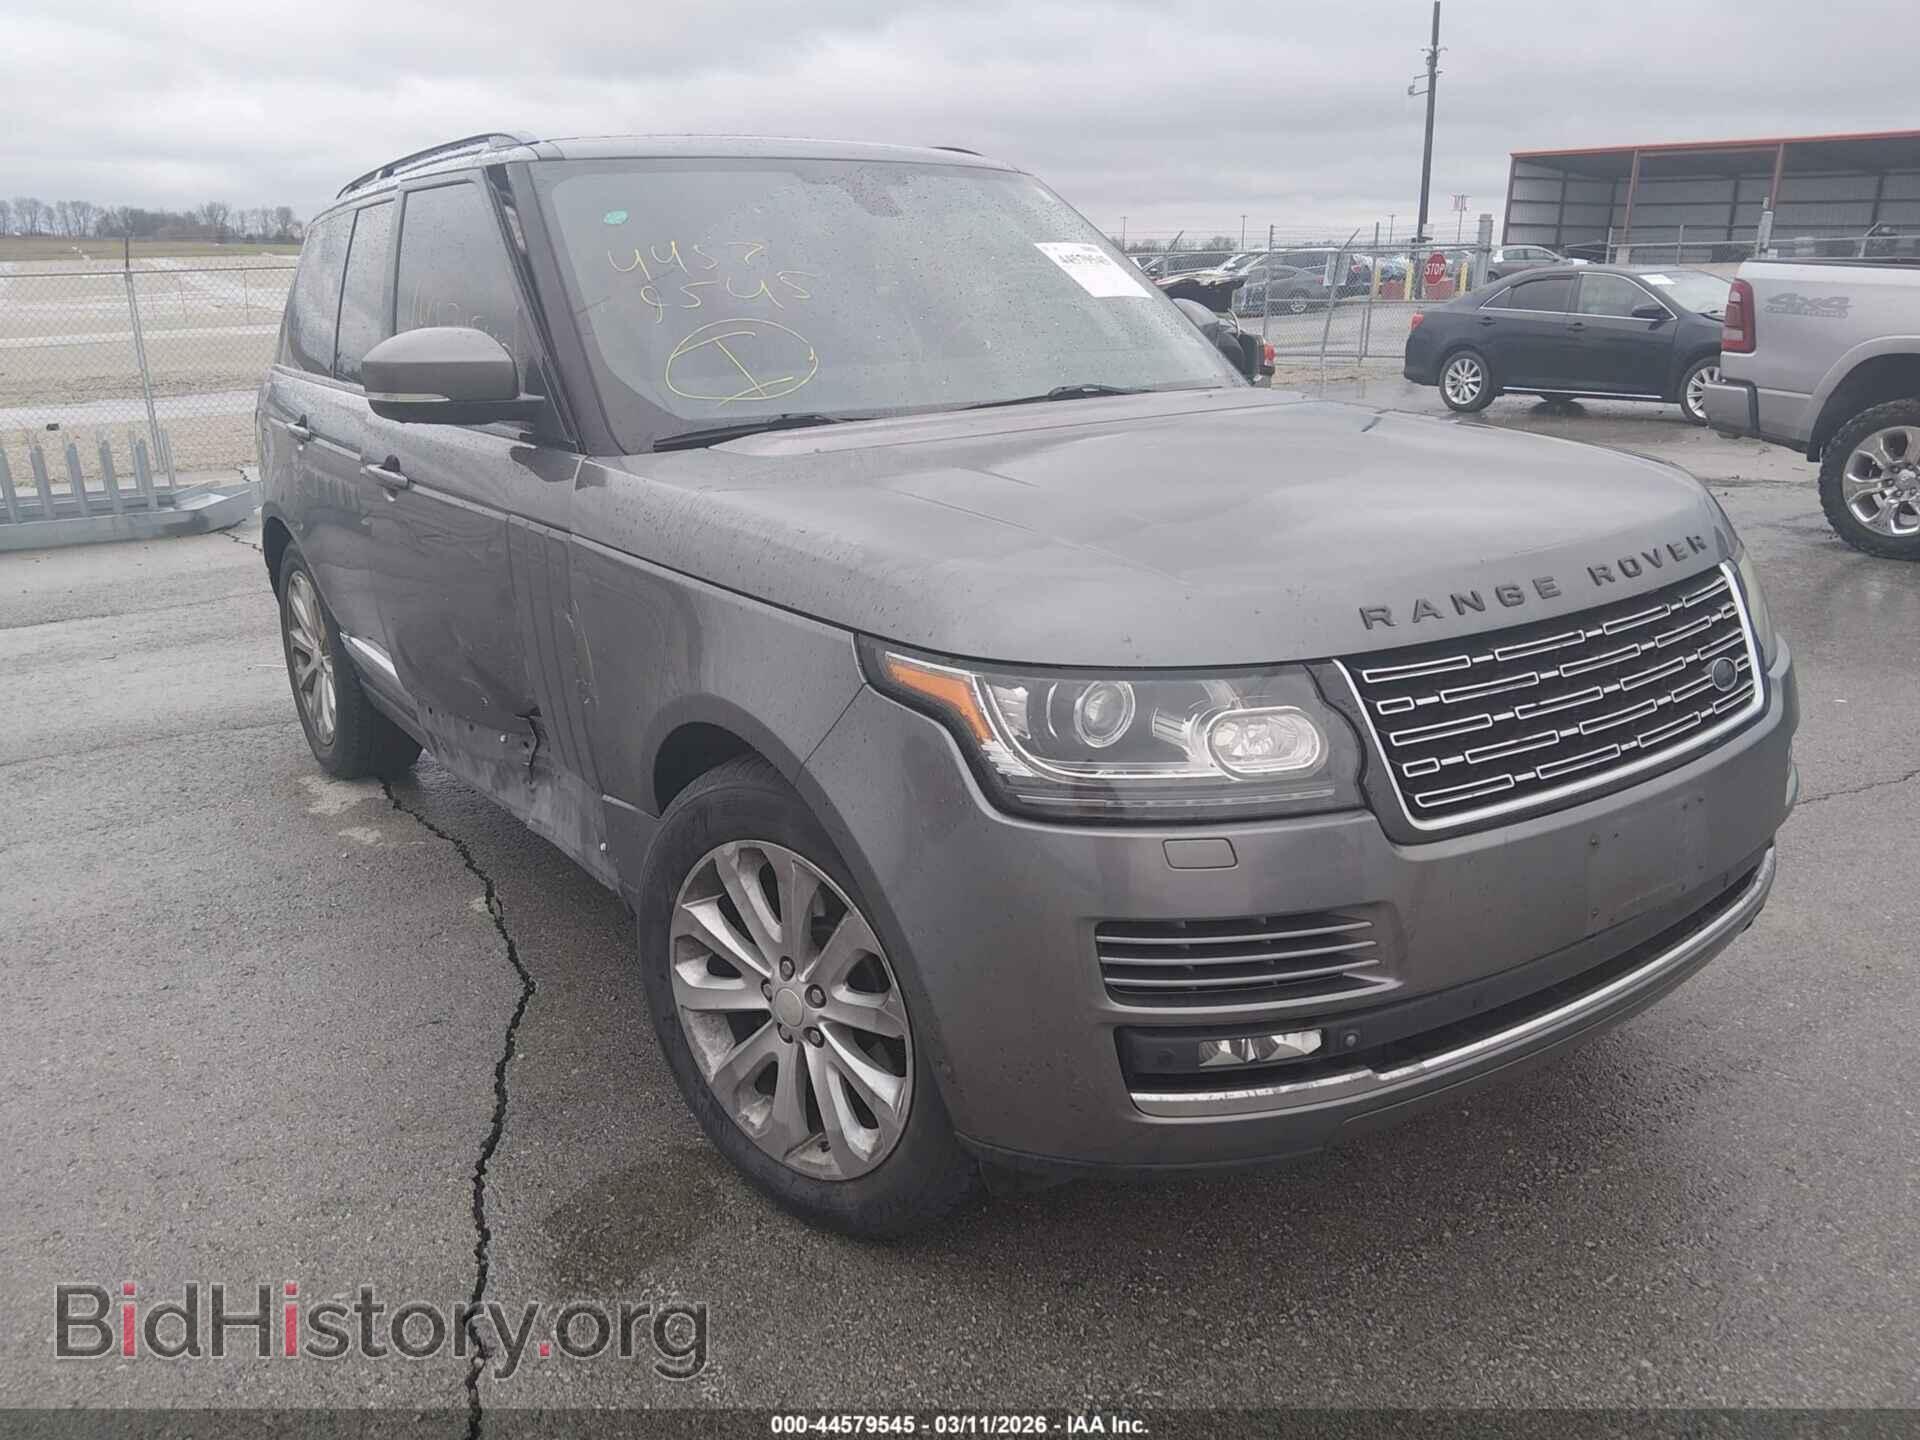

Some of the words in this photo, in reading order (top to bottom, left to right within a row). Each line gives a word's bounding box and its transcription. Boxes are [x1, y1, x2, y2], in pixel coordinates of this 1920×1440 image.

[1425, 263, 1446, 275] STOP
[1358, 575, 1562, 630] RANGE
[1586, 535, 1707, 587] ROVER
